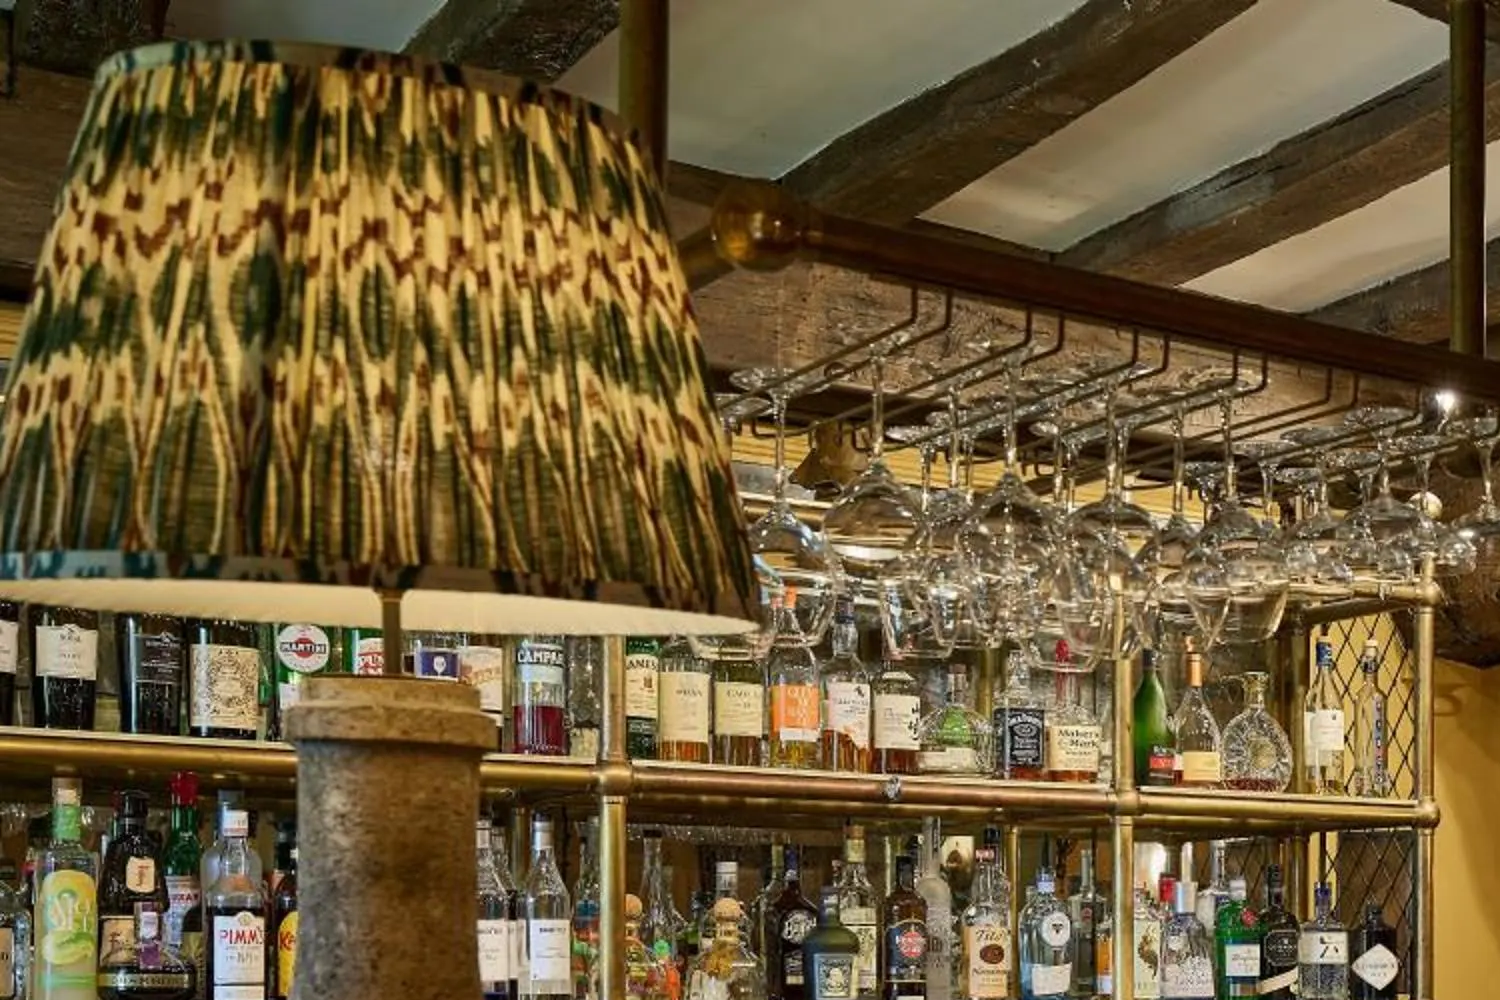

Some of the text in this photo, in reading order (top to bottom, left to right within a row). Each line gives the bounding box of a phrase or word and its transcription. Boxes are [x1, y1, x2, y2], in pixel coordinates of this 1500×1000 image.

[280, 641, 327, 655] MARTINI
[1058, 729, 1100, 738] Maker's
[1068, 739, 1099, 748] Mark
